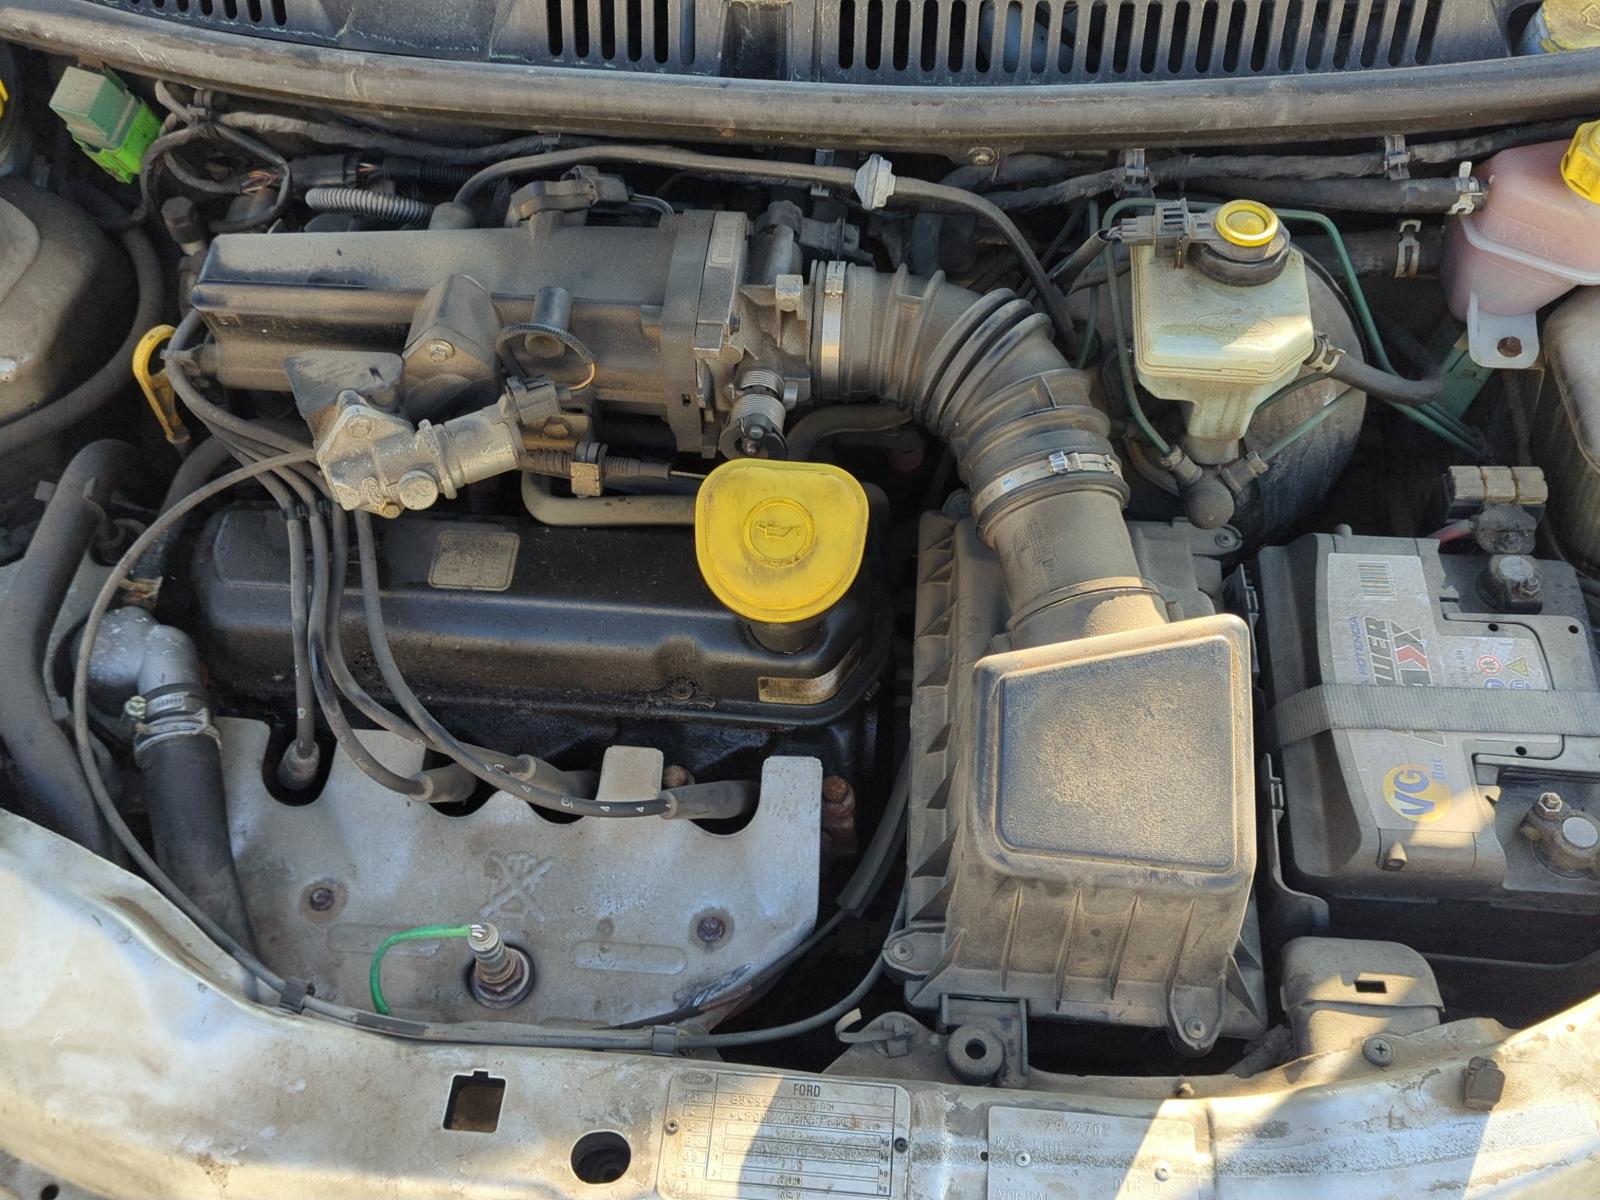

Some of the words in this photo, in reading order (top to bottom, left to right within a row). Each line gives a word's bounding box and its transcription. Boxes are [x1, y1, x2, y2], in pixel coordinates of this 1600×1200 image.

[1349, 615, 1369, 676] POTENCIA
[1364, 615, 1399, 687] WER
[1430, 758, 1445, 780] Bat
[1393, 769, 1434, 815] VG
[793, 1083, 821, 1097] FORD
[879, 1170, 888, 1179] kg
[878, 1184, 888, 1193] kg
